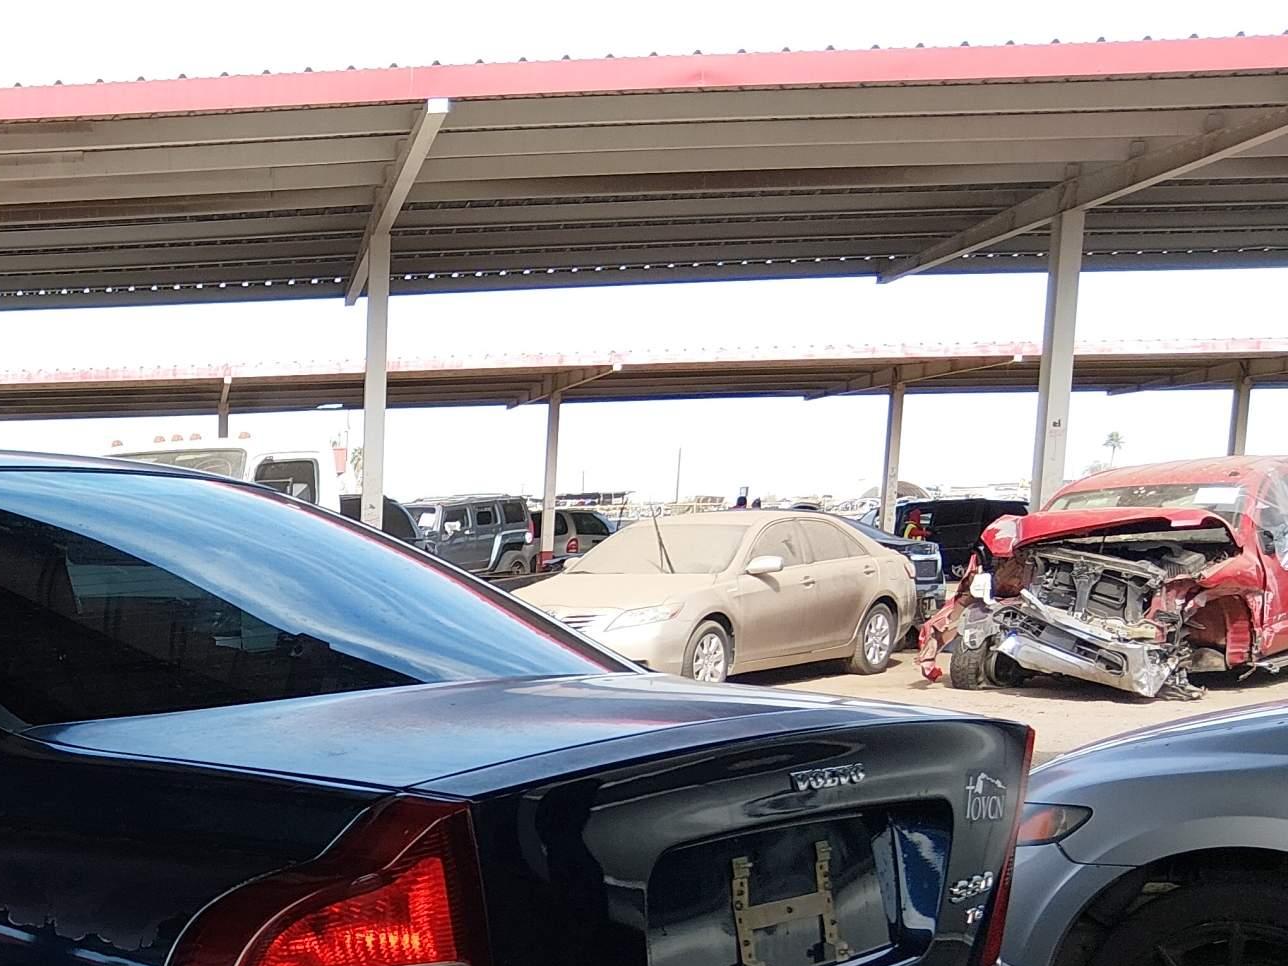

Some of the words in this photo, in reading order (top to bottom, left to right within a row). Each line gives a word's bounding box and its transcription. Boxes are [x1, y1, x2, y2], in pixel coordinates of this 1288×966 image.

[790, 763, 865, 791] VOLVO
[949, 871, 993, 902] S80
[965, 905, 984, 923] T6
